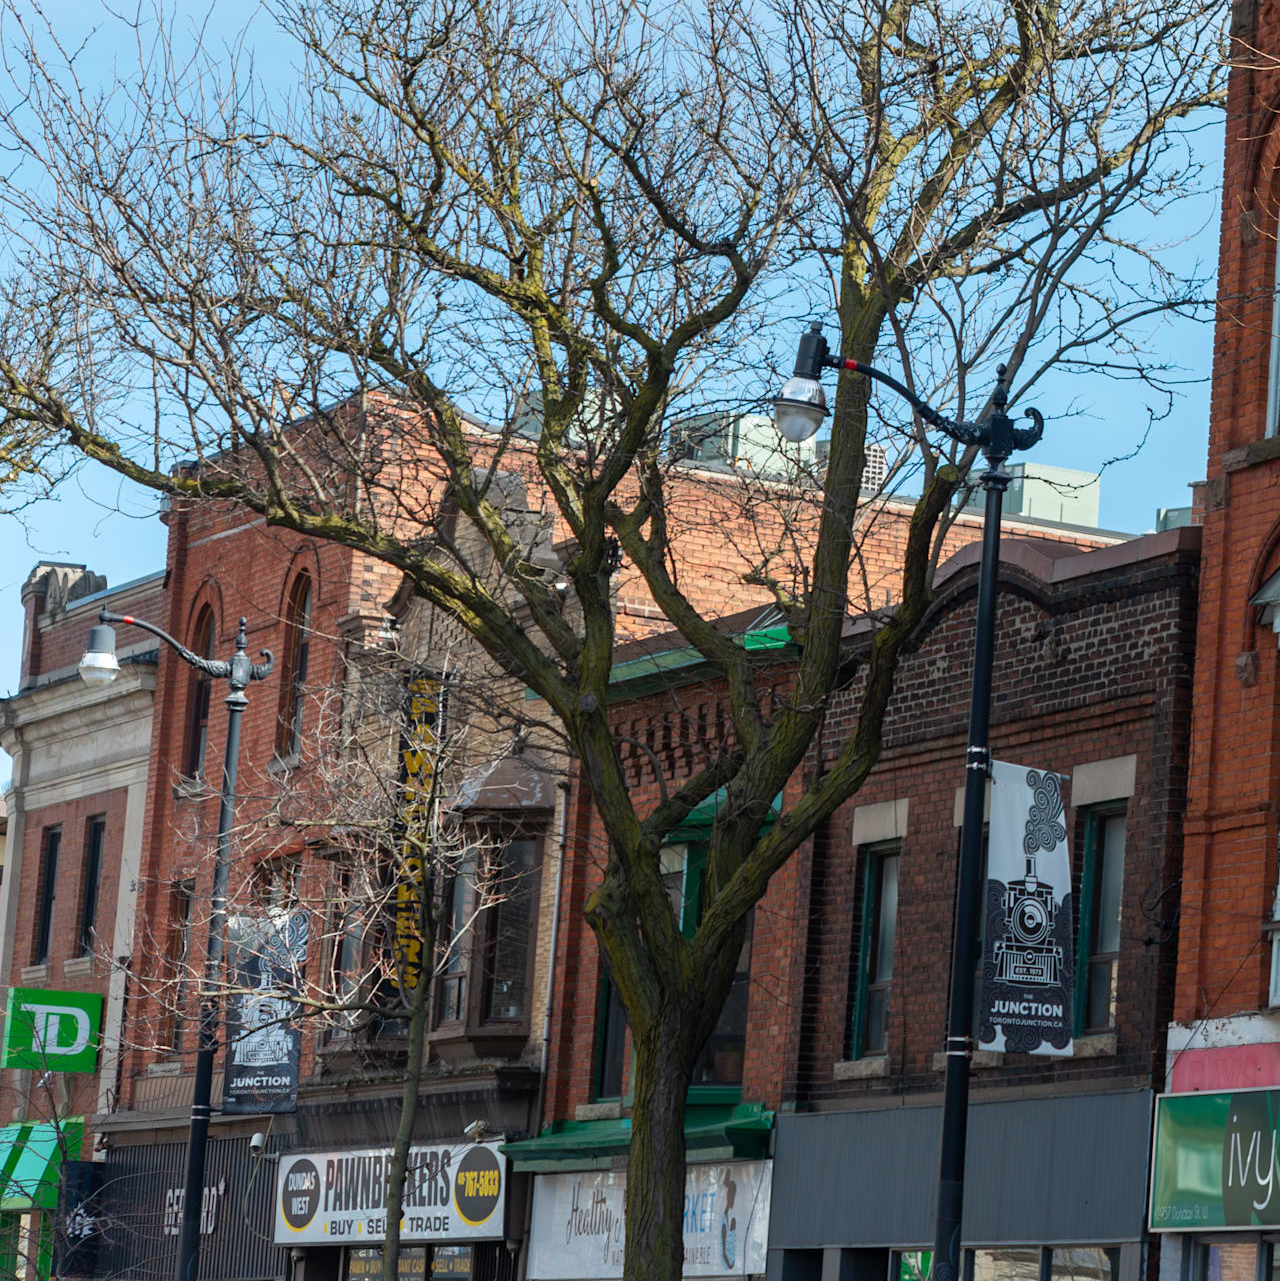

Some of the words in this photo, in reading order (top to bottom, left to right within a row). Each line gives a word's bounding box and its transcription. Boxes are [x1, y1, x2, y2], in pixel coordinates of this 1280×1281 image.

[990, 1000, 1063, 1017] JUNCTION
[20, 1003, 91, 1056] TD
[989, 1017, 1063, 1028] TORONTOJUNCTION.CA
[230, 1076, 291, 1087] JUNCTION
[288, 1171, 316, 1191] DUNDAS
[323, 1149, 451, 1212] PAWNBRKERS
[291, 1196, 310, 1215] WEST
[330, 1220, 354, 1235] BUY
[367, 1219, 387, 1234] SEL
[409, 1216, 450, 1232] TRADE
[567, 1181, 614, 1265] Healthy
